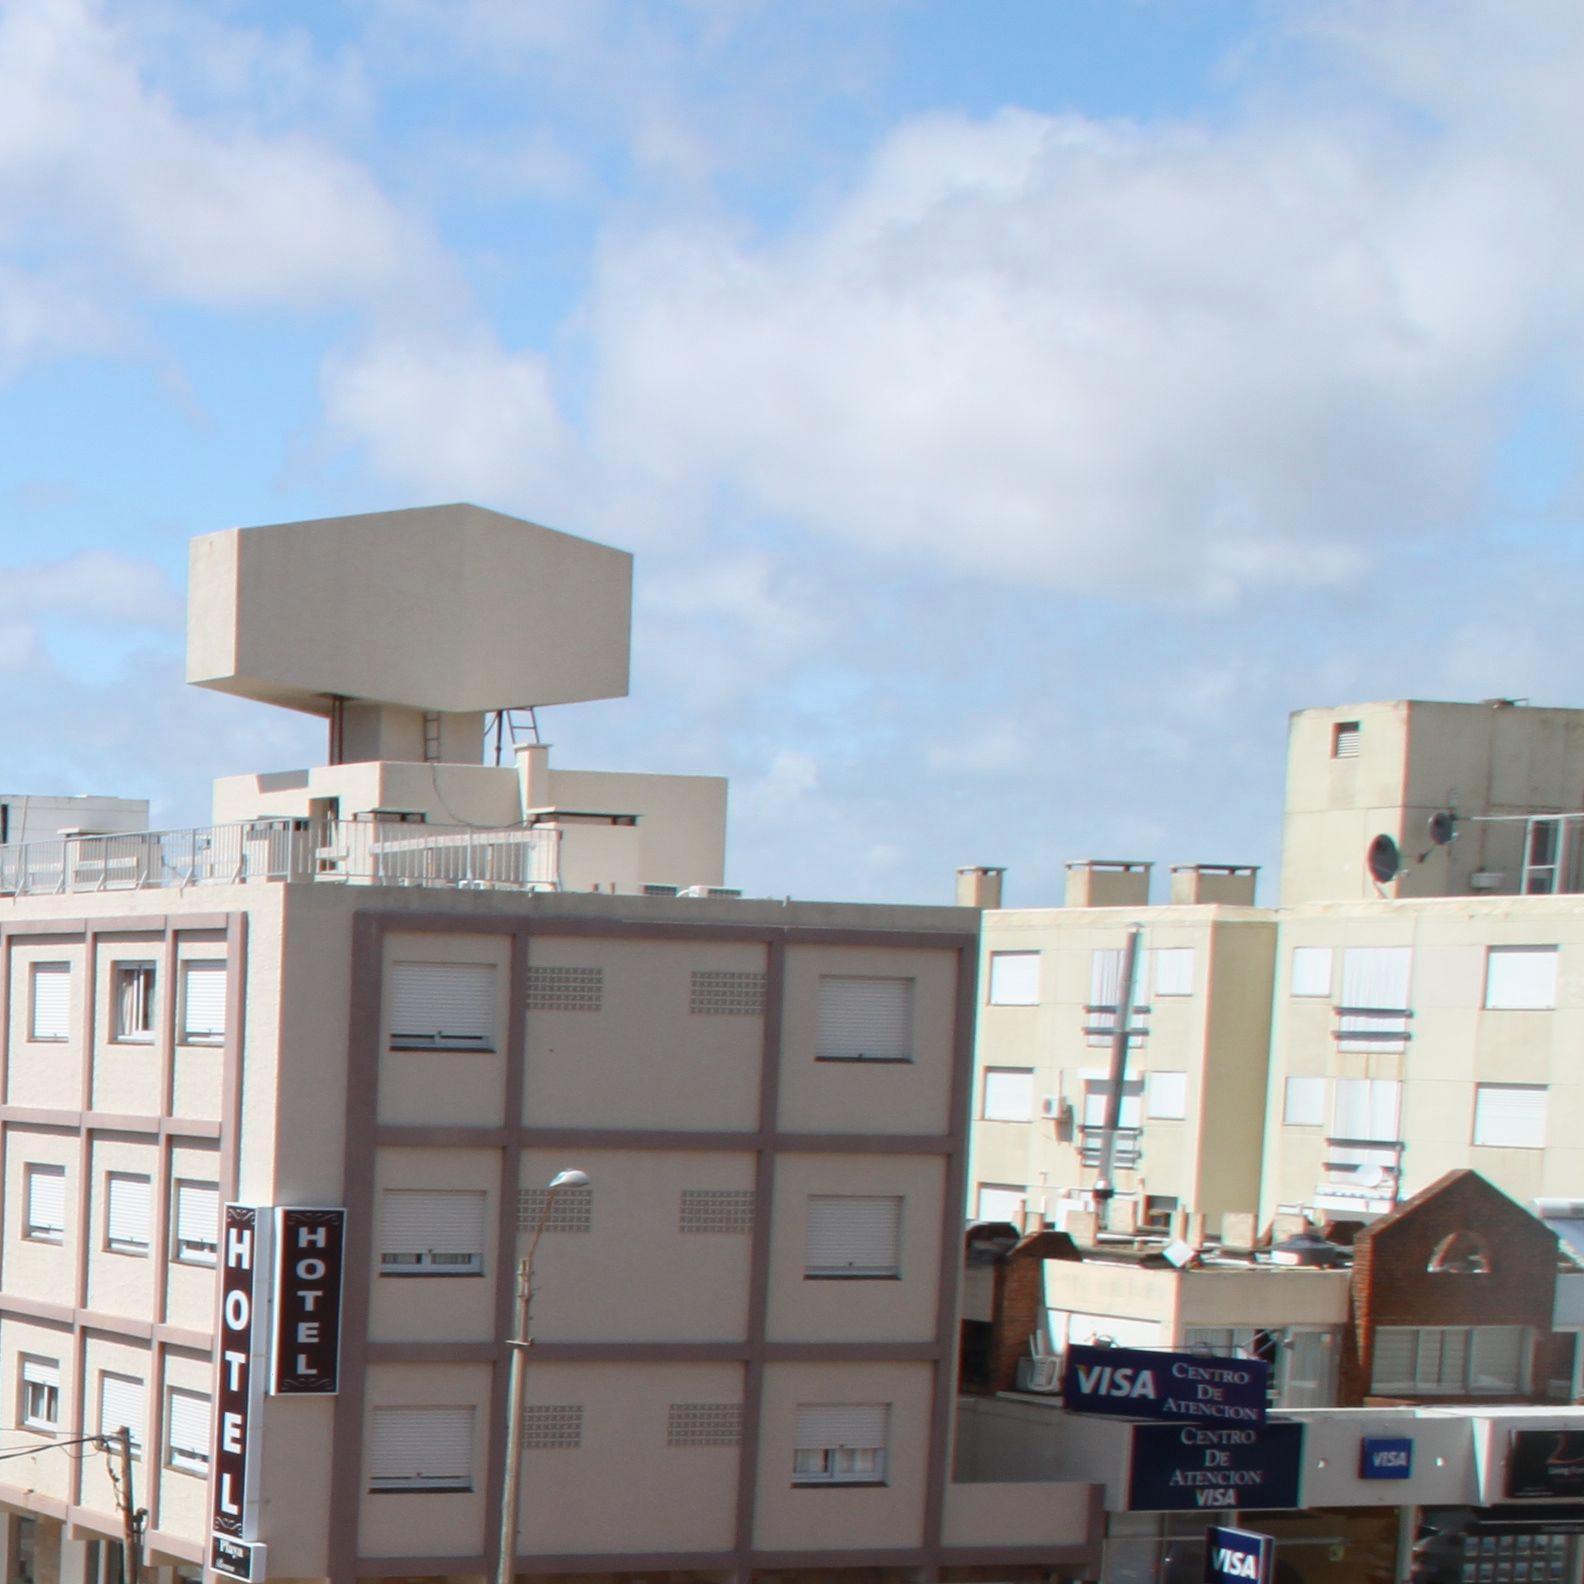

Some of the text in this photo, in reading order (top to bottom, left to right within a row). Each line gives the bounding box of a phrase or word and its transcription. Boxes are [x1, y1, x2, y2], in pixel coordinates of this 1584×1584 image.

[295, 1226, 327, 1375] HOTEL
[220, 1228, 251, 1516] HOTEL
[1075, 1364, 1158, 1399] VISA
[1172, 1362, 1250, 1385] CENTRO
[1163, 1398, 1258, 1421] ATENCION
[1181, 1427, 1256, 1445] CENTRO
[1372, 1451, 1408, 1467] VISA
[1170, 1470, 1262, 1487] ATENCION
[1196, 1488, 1237, 1507] VISA
[1211, 1546, 1259, 1580] VISA
